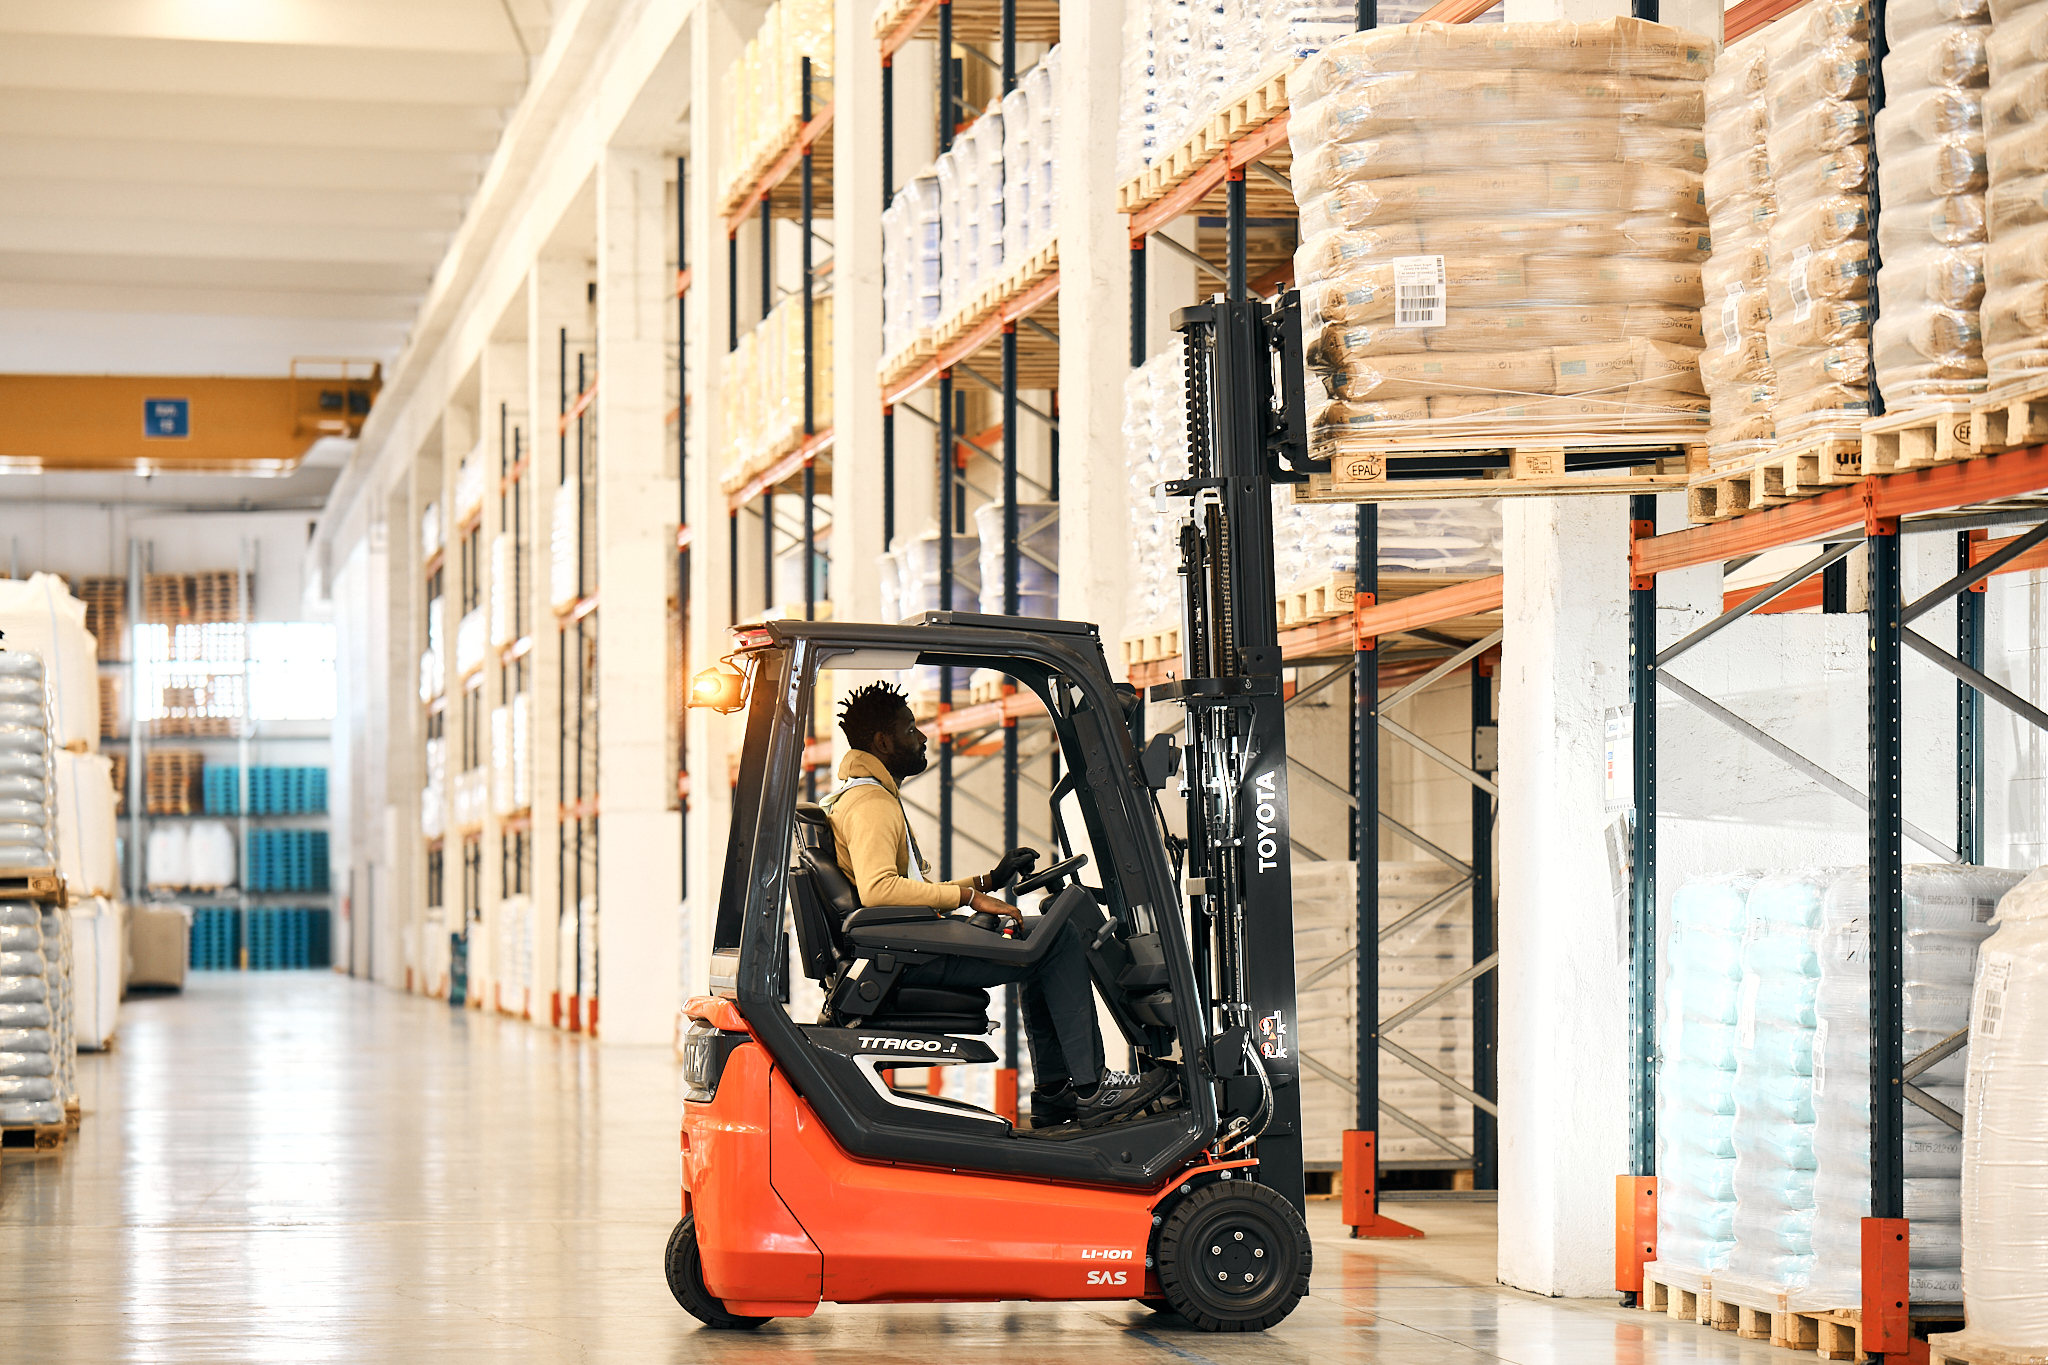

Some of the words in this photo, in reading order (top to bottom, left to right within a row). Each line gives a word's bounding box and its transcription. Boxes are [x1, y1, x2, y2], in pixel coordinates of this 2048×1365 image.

[1351, 464, 1377, 477] EPAL
[1339, 589, 1354, 600] EPA
[1255, 770, 1278, 874] TOYOTA
[1086, 1270, 1128, 1285] SAS
